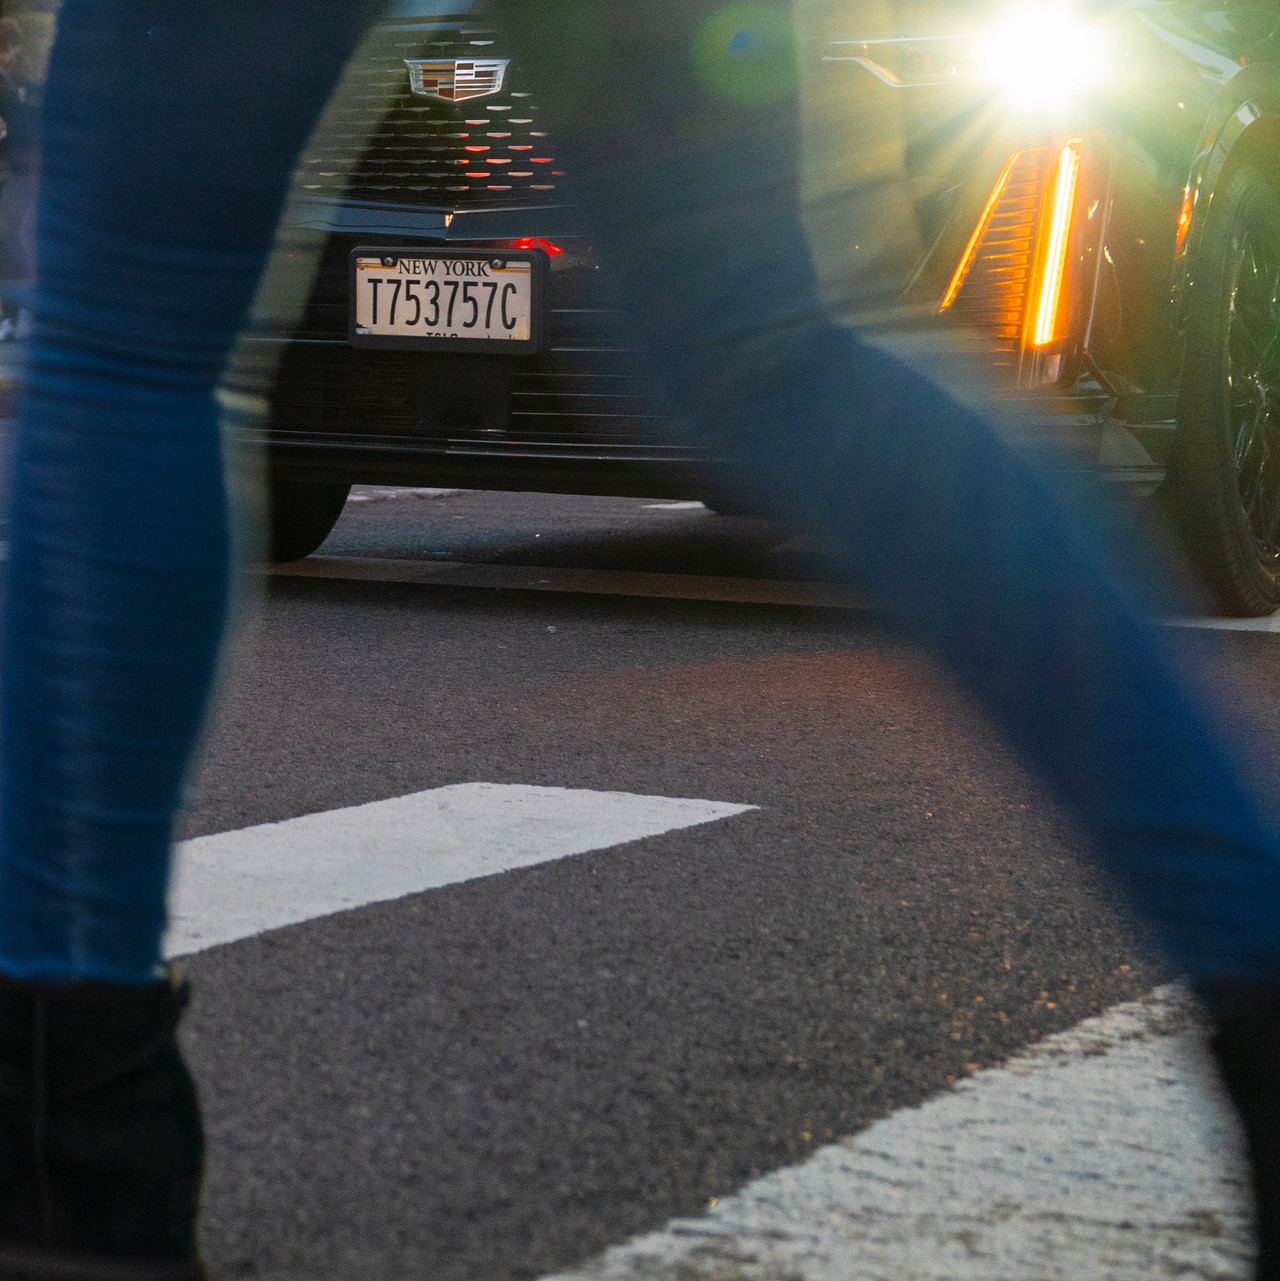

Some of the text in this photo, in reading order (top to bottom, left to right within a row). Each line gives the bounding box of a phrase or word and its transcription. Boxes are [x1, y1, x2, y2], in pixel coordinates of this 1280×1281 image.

[398, 259, 490, 277] NEW YORK
[367, 278, 517, 330] T753757C
